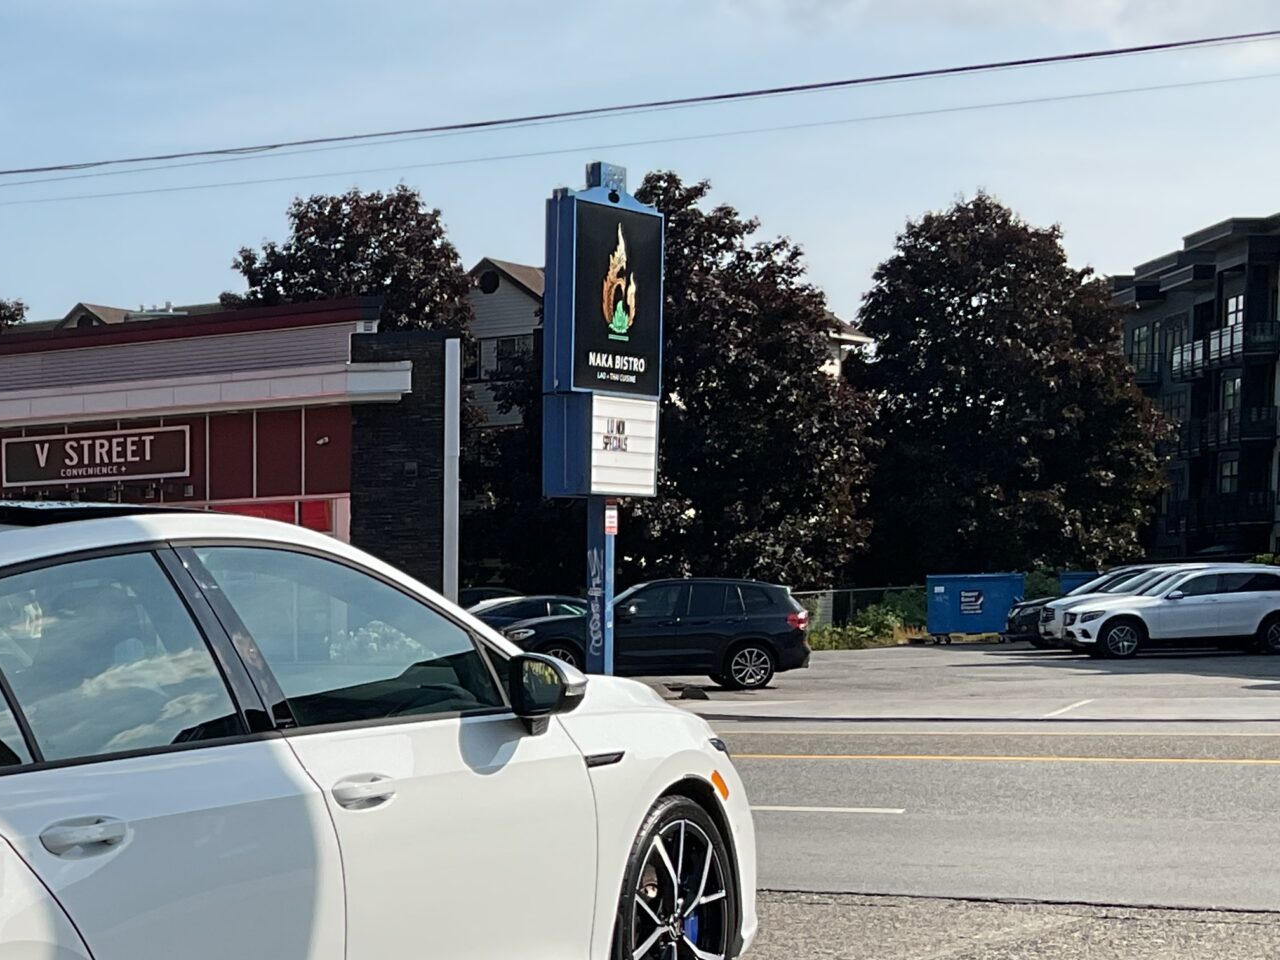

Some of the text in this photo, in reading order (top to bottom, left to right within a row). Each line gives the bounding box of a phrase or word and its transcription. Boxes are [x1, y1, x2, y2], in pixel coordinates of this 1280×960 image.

[588, 351, 645, 372] NAKA BISTRO
[35, 435, 155, 468] V STREET
[60, 465, 118, 477] CONVENIENCE
